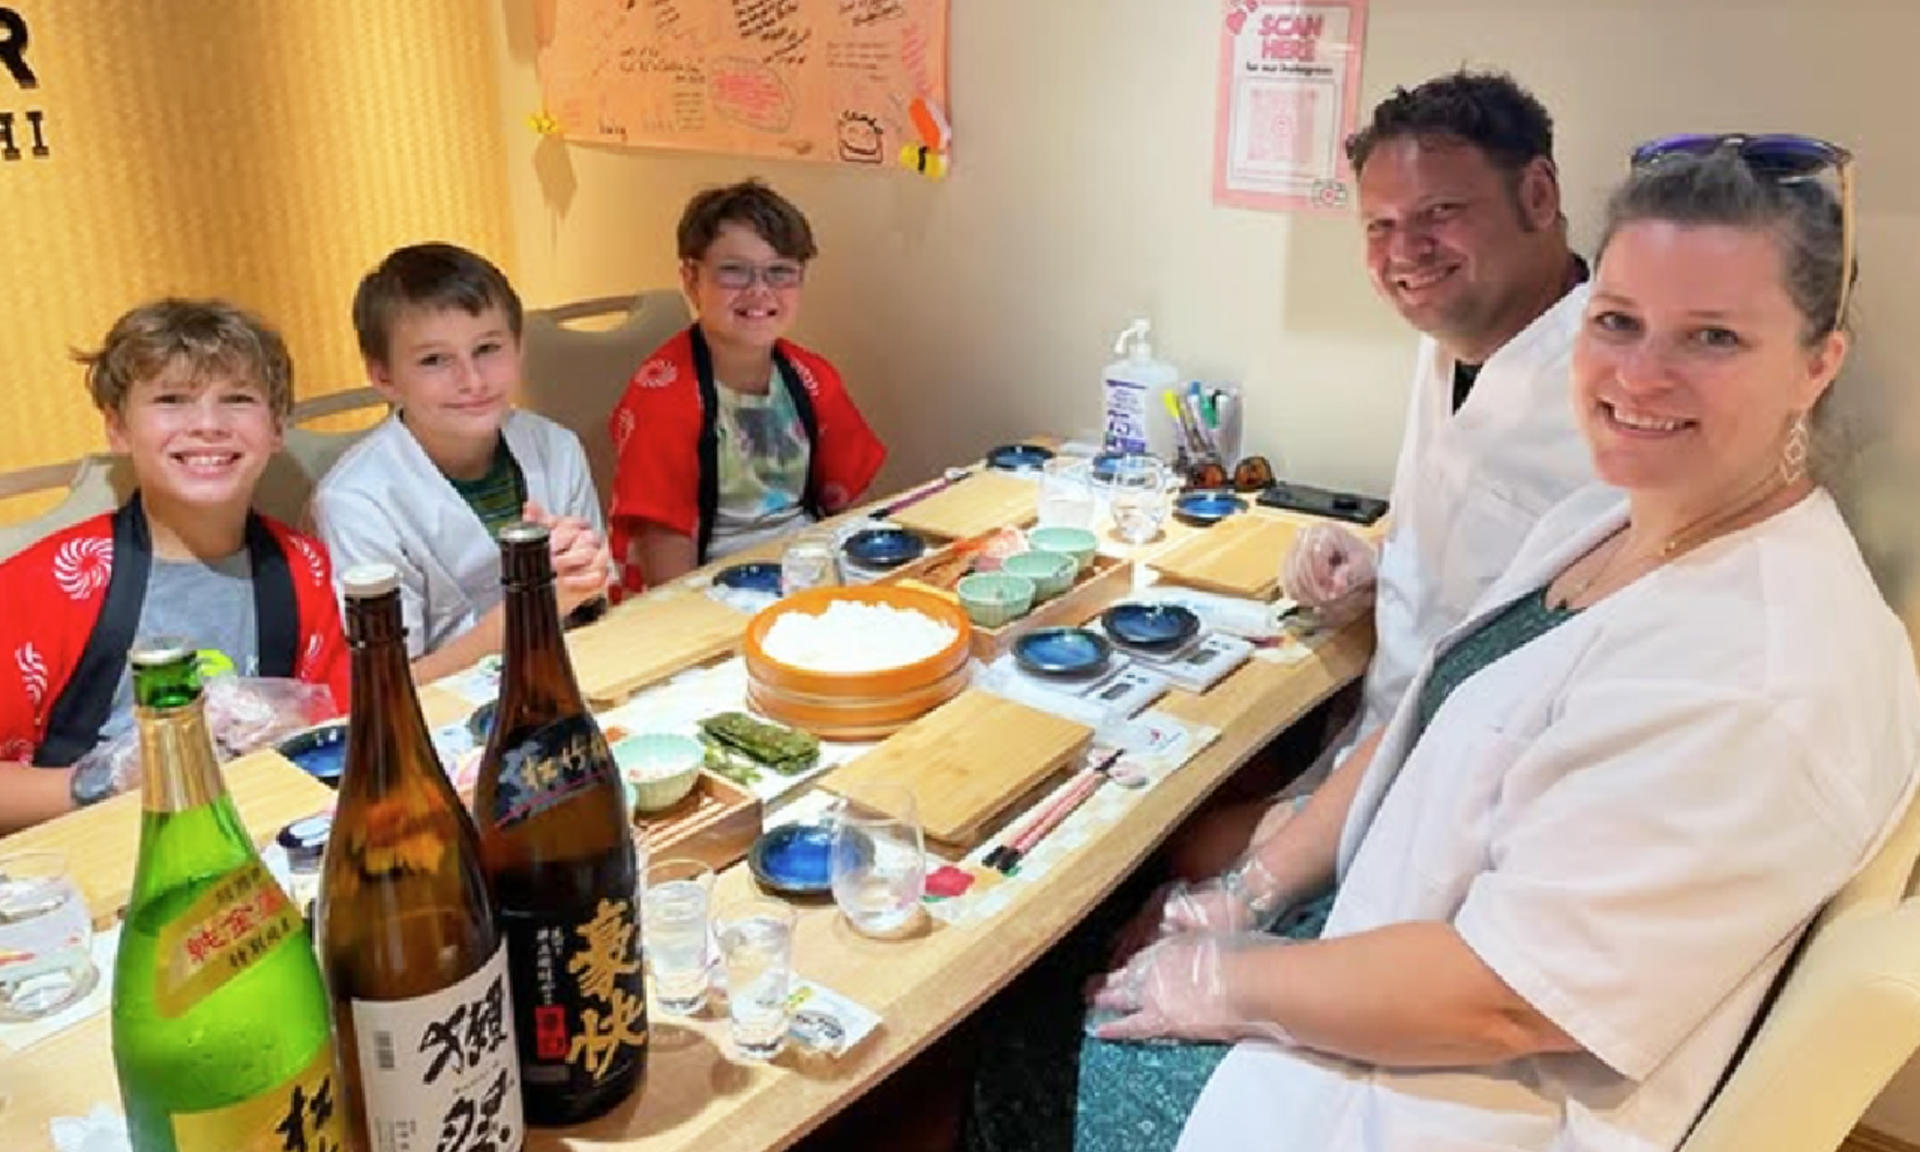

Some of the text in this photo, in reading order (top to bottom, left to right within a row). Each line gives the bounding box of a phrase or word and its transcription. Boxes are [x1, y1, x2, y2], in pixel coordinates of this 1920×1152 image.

[1257, 14, 1323, 36] SCAN
[1262, 38, 1316, 61] HERE
[565, 897, 648, 1081] 豪快
[275, 1073, 341, 1152] 松
